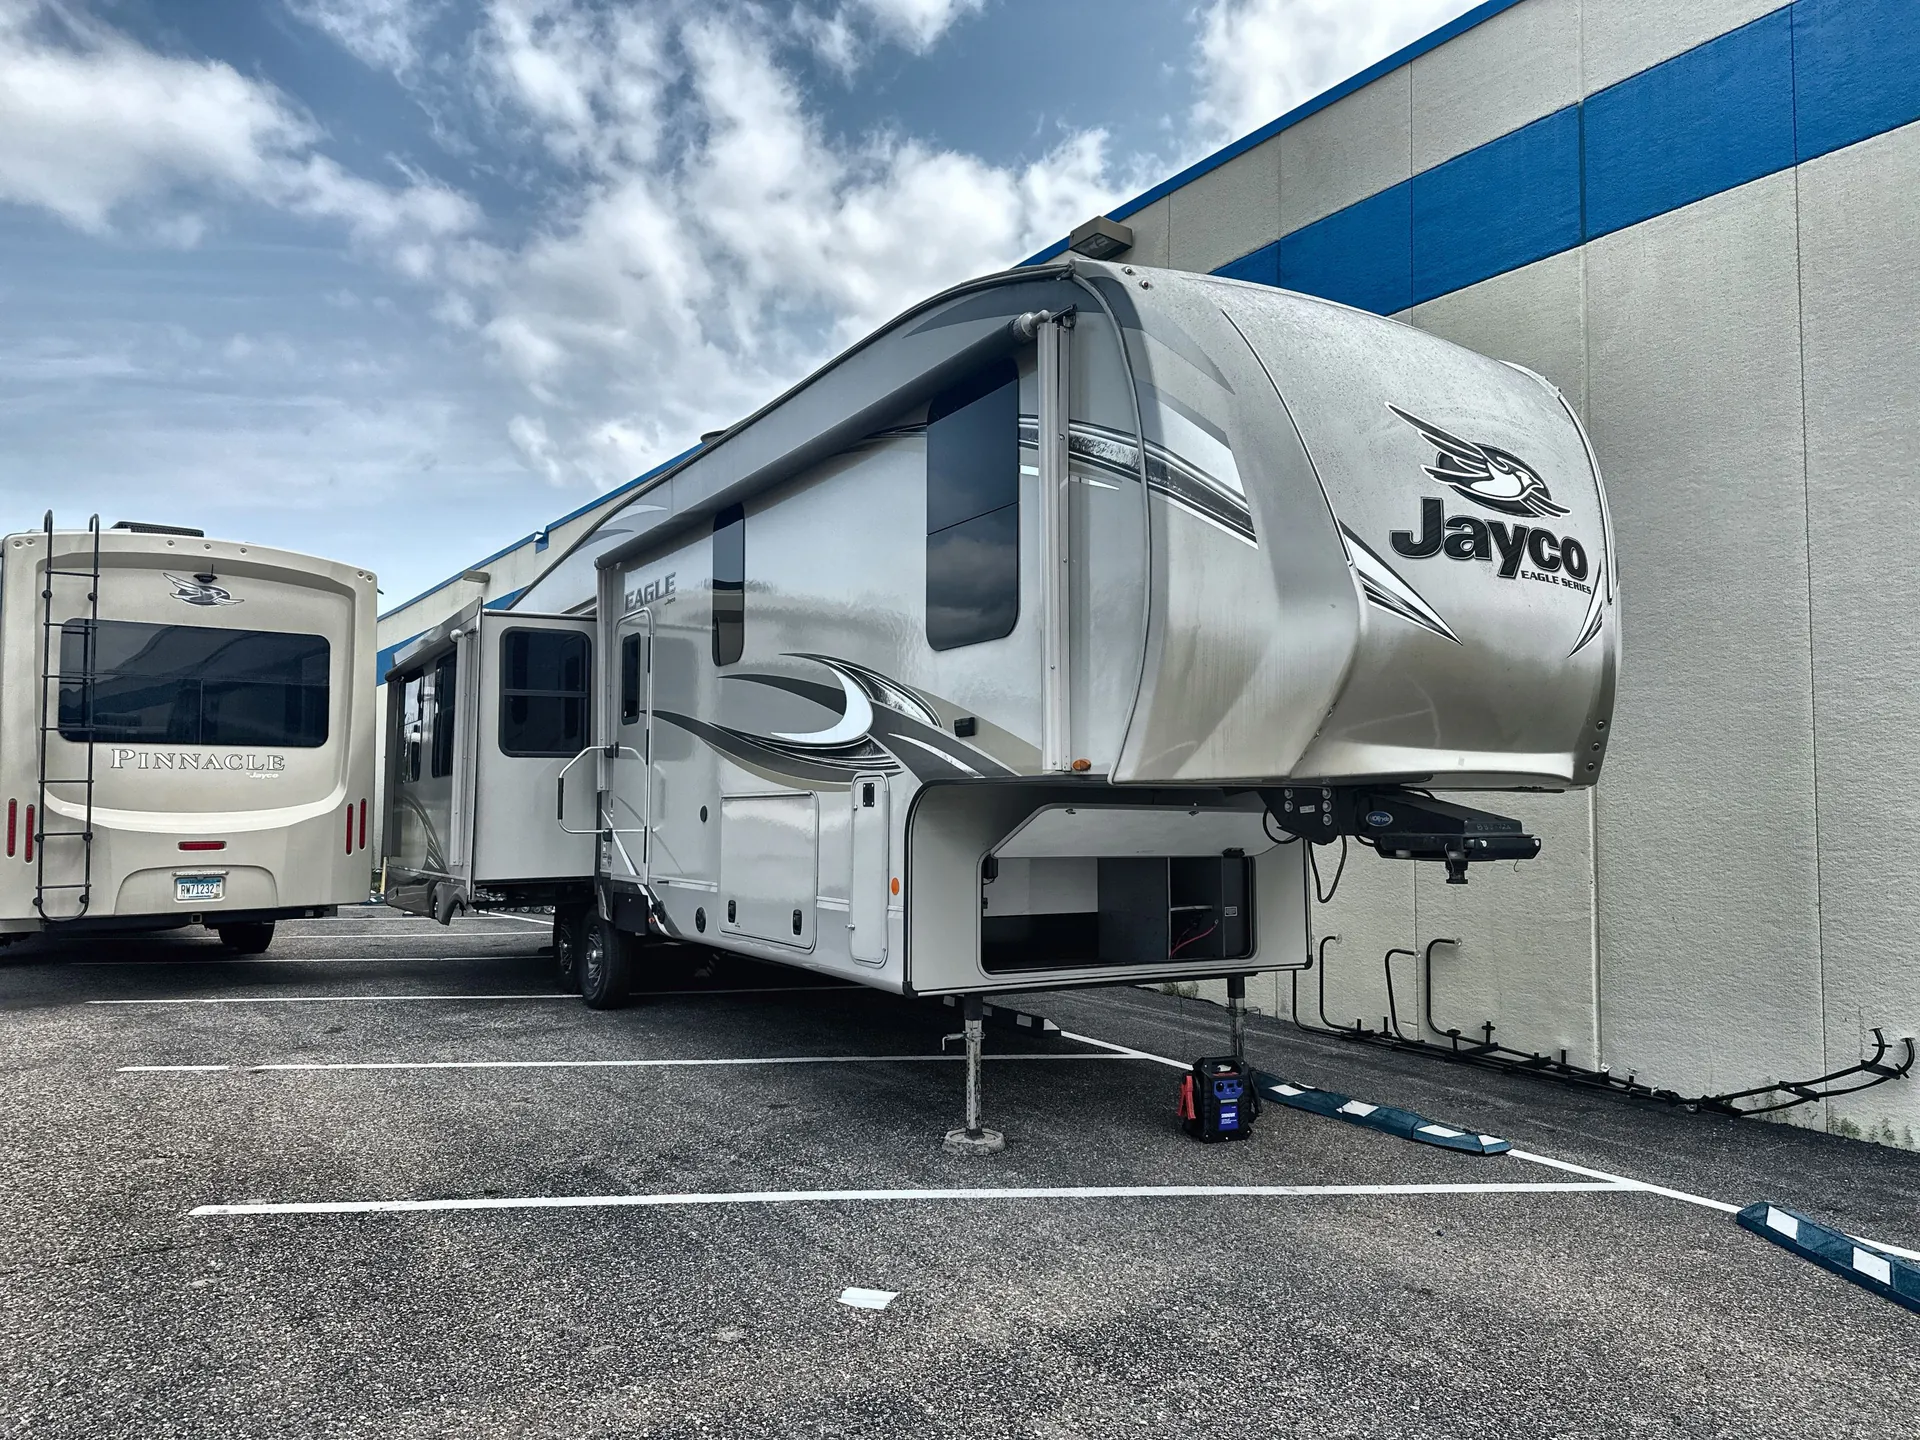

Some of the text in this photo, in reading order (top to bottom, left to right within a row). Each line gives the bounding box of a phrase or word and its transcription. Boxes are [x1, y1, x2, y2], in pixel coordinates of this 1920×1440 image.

[1389, 496, 1588, 581] Jayco
[624, 572, 676, 613] EAGLE
[1520, 570, 1592, 595] EAGLE SERIES
[110, 748, 286, 771] PINNACLE
[249, 772, 280, 780] Jayco
[180, 884, 215, 895] RW71232
